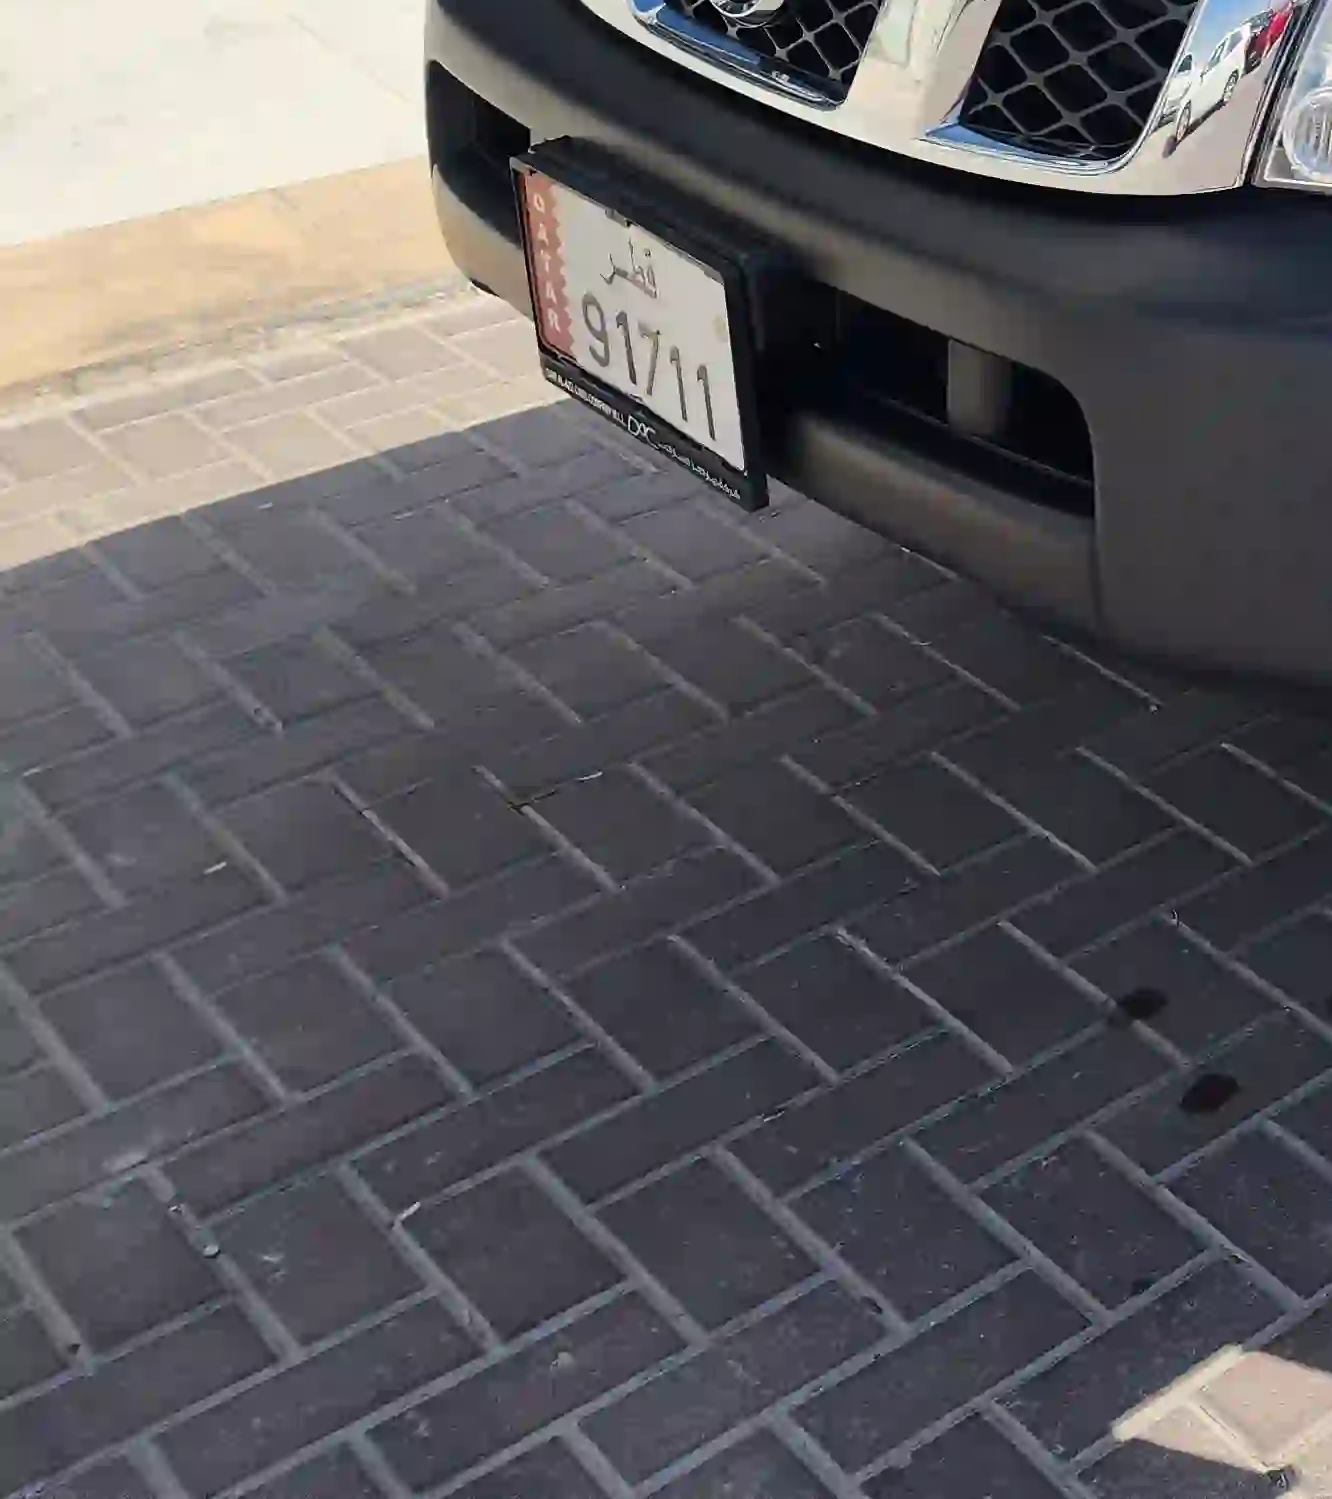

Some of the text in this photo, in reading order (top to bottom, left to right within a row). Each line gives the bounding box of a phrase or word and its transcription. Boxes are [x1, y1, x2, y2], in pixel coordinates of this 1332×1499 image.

[532, 192, 562, 334] QATAR
[599, 240, 659, 300] قطر
[580, 291, 718, 441] 91711
